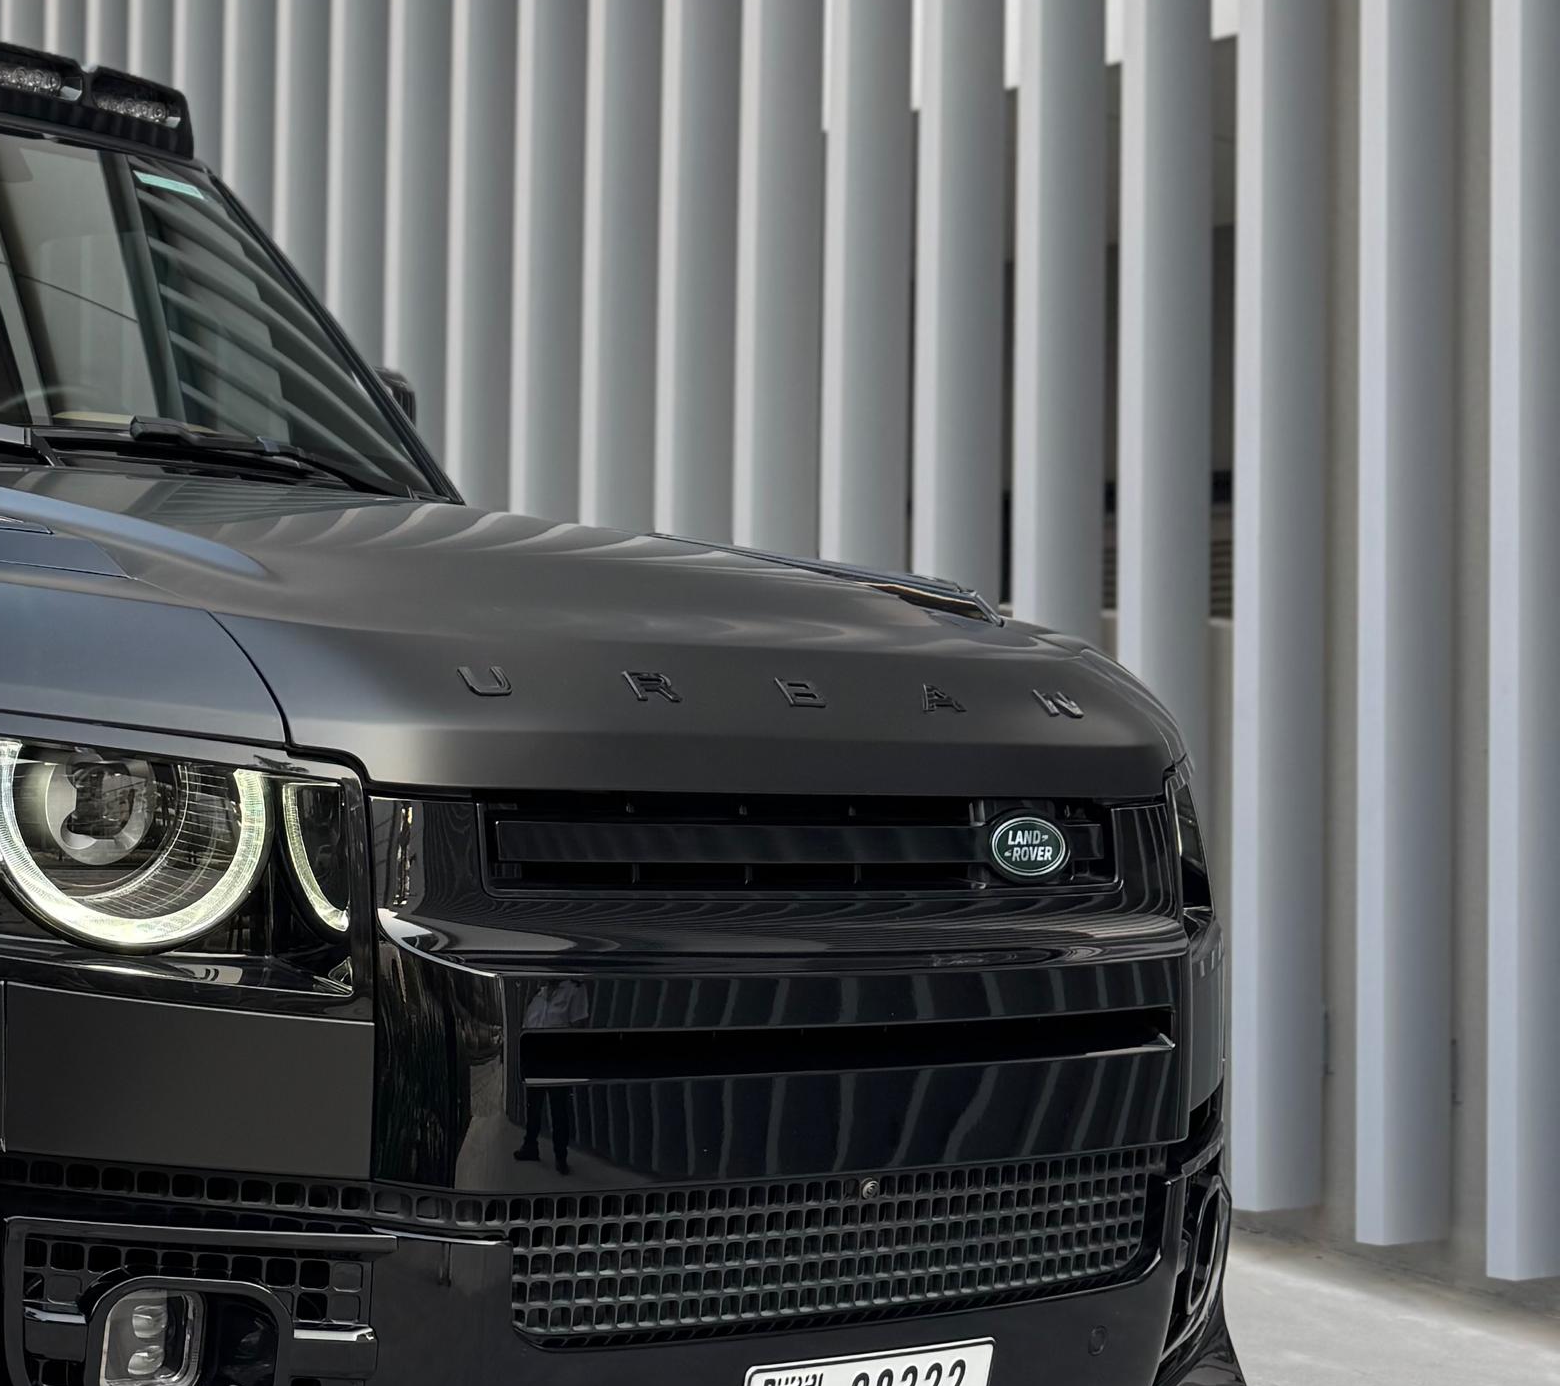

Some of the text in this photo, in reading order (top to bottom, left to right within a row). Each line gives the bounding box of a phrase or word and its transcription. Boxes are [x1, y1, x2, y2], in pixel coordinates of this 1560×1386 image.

[457, 664, 1085, 720] URBAN
[1007, 829, 1041, 846] LAND
[1011, 846, 1053, 862] ROVER
